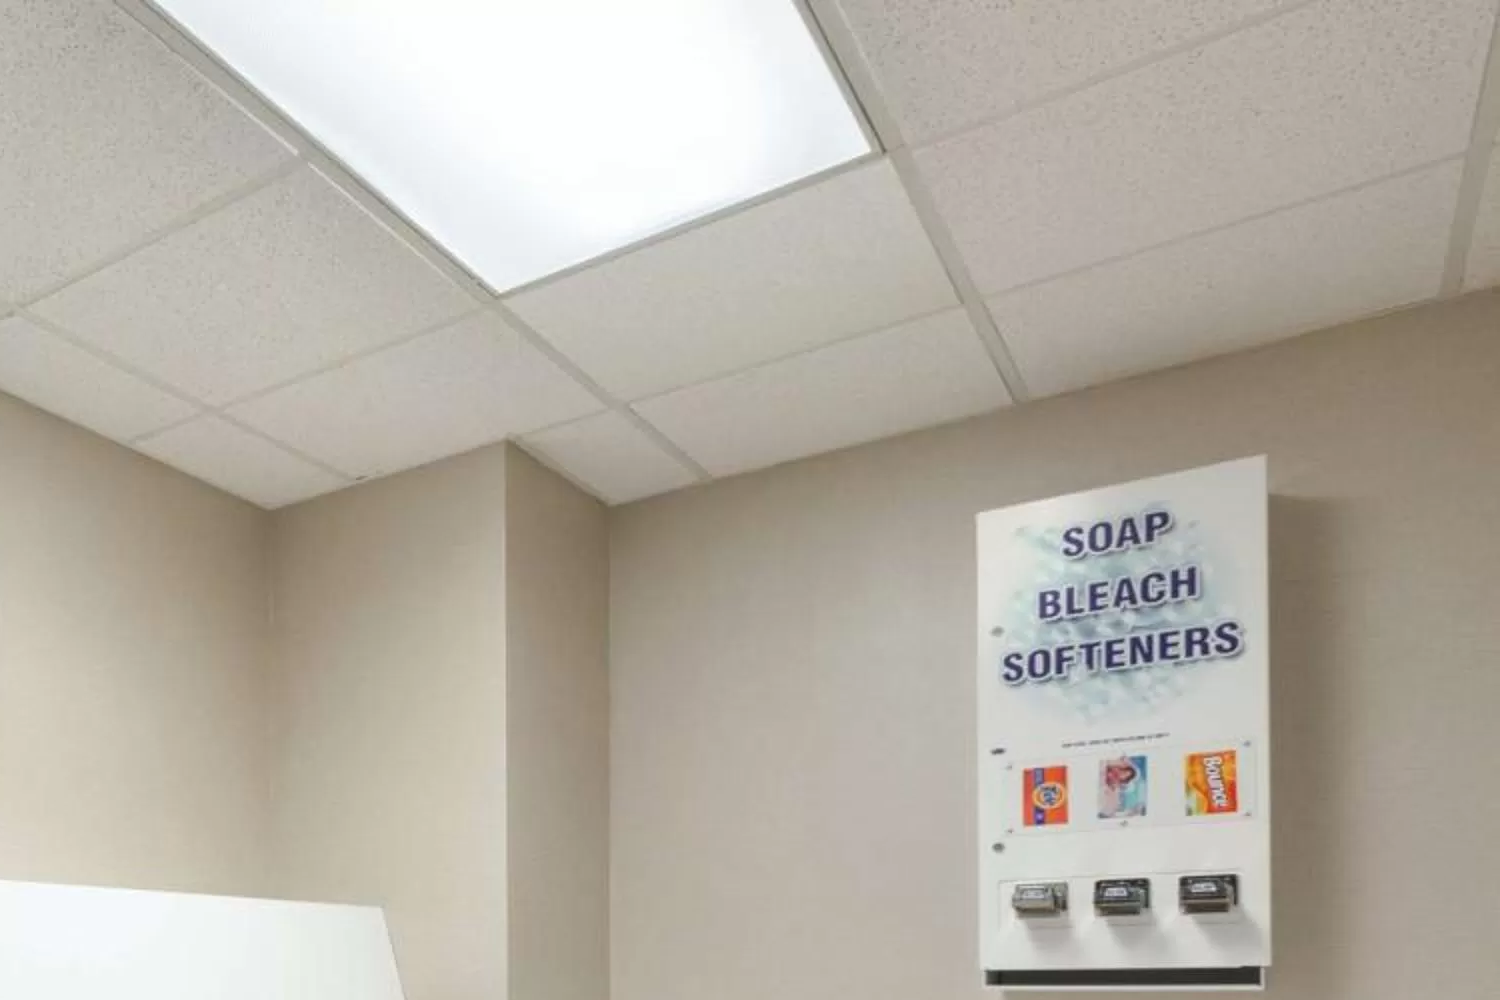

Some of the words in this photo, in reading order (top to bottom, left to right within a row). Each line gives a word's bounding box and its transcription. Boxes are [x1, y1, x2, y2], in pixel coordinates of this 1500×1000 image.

[1061, 510, 1171, 558] SOAP
[1038, 566, 1198, 620] BLEACH
[1002, 621, 1240, 682] SOFTENERS
